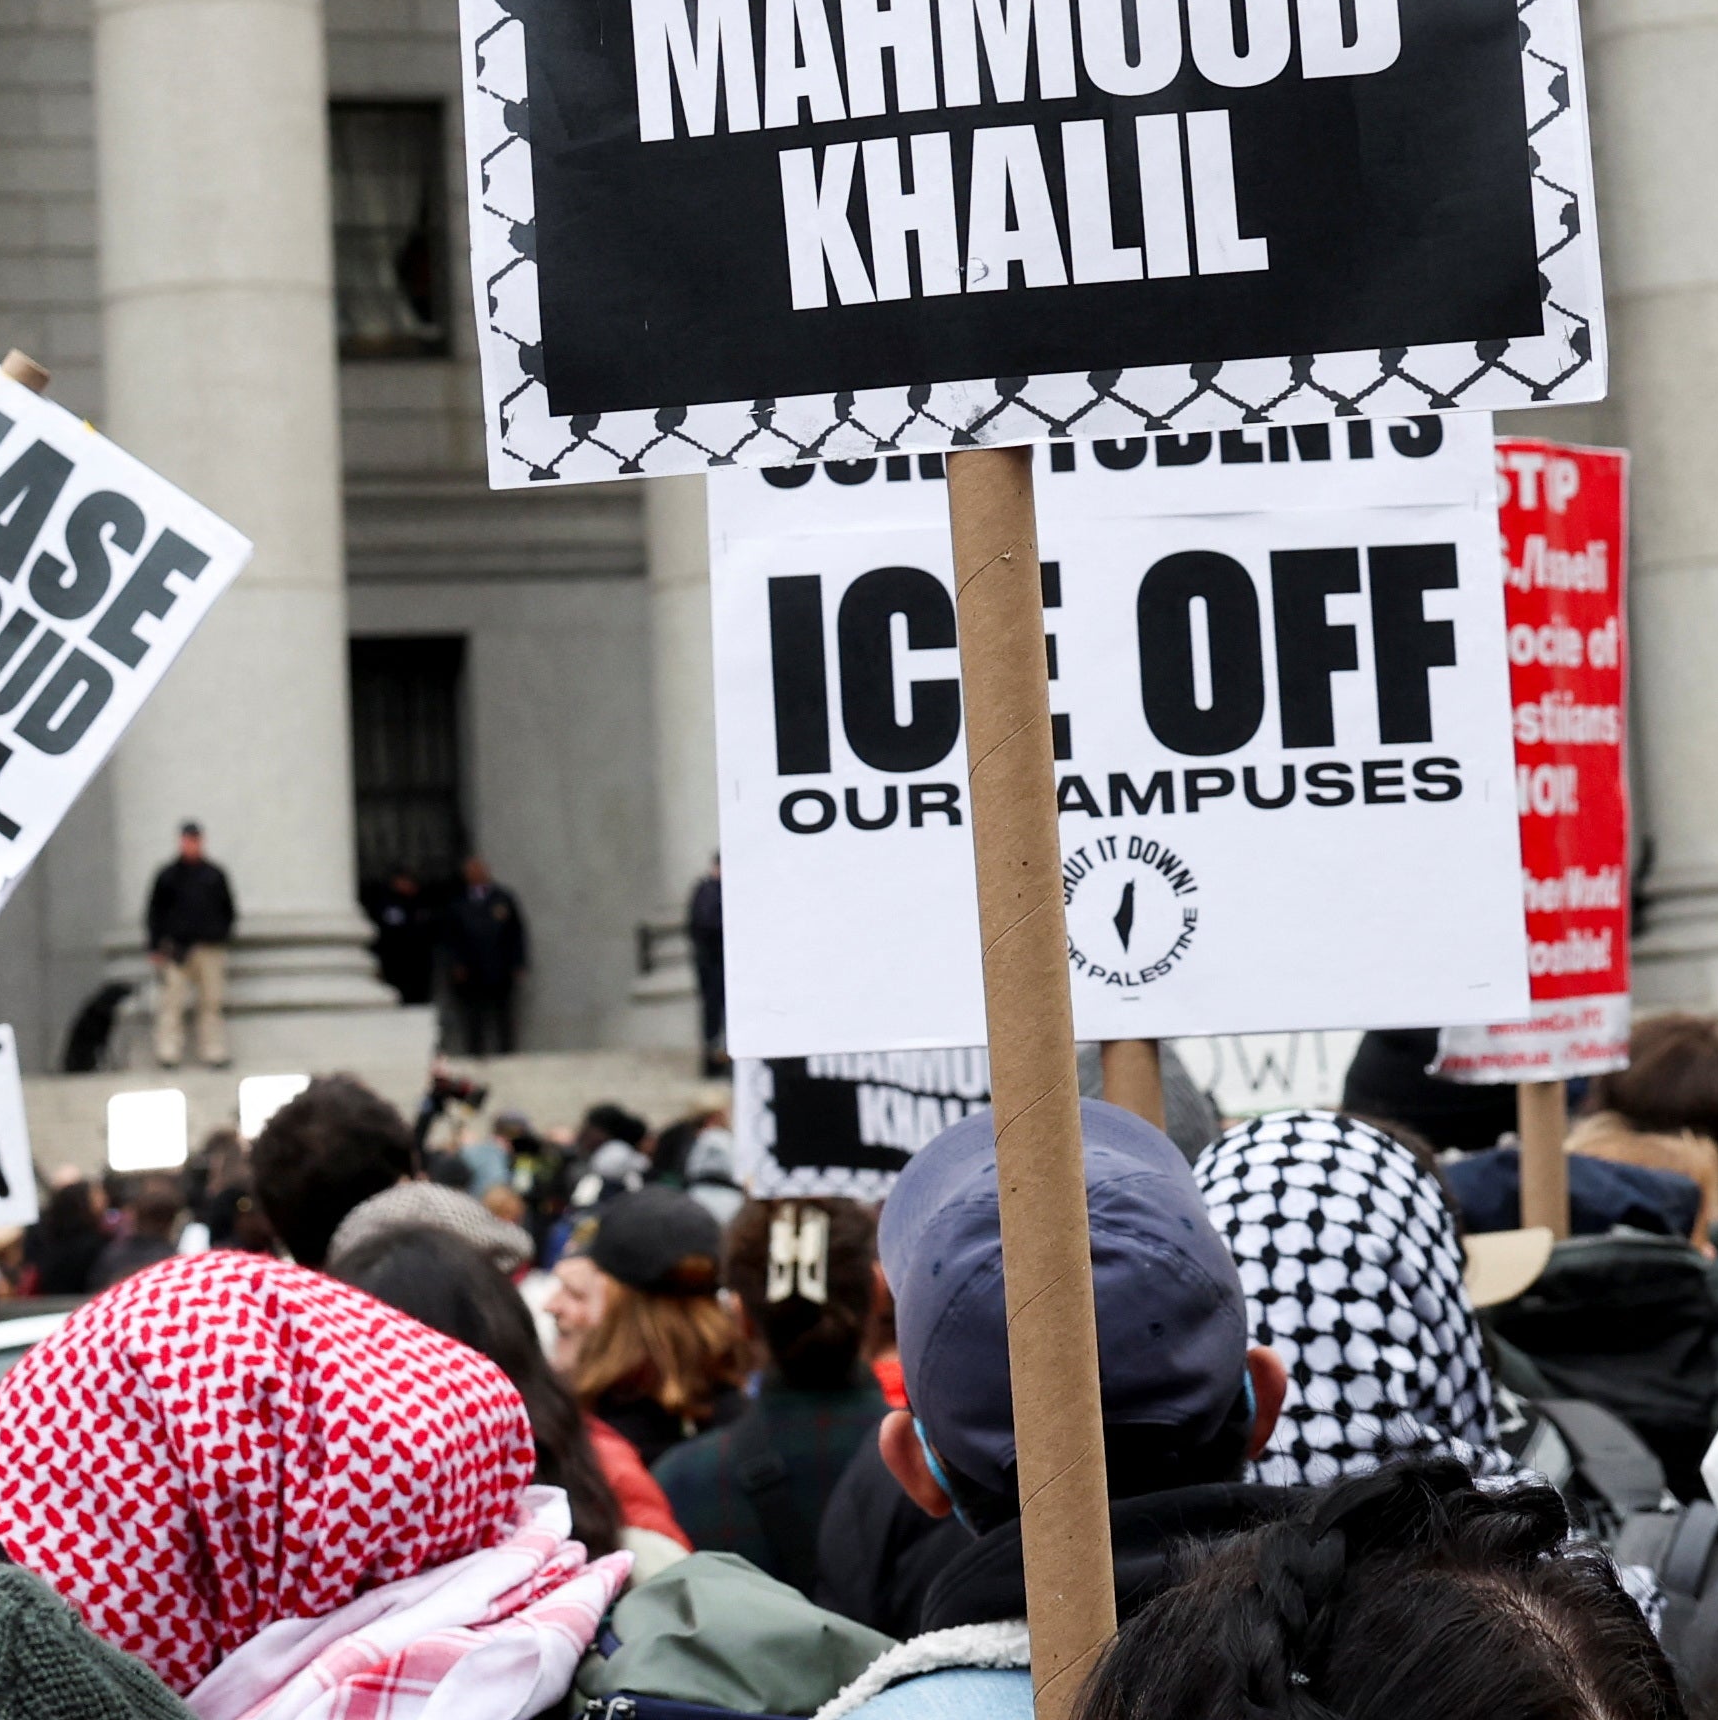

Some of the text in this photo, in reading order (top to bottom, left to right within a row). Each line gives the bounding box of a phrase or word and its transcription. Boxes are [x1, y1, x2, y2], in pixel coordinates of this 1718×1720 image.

[778, 108, 1270, 311] KHALIL
[767, 542, 1458, 777] IC OFF
[778, 756, 1464, 835] OUR AMPUSES
[1097, 835, 1117, 862] IT
[1127, 835, 1198, 897] DOWN!
[1088, 907, 1198, 987] PALESTINE
